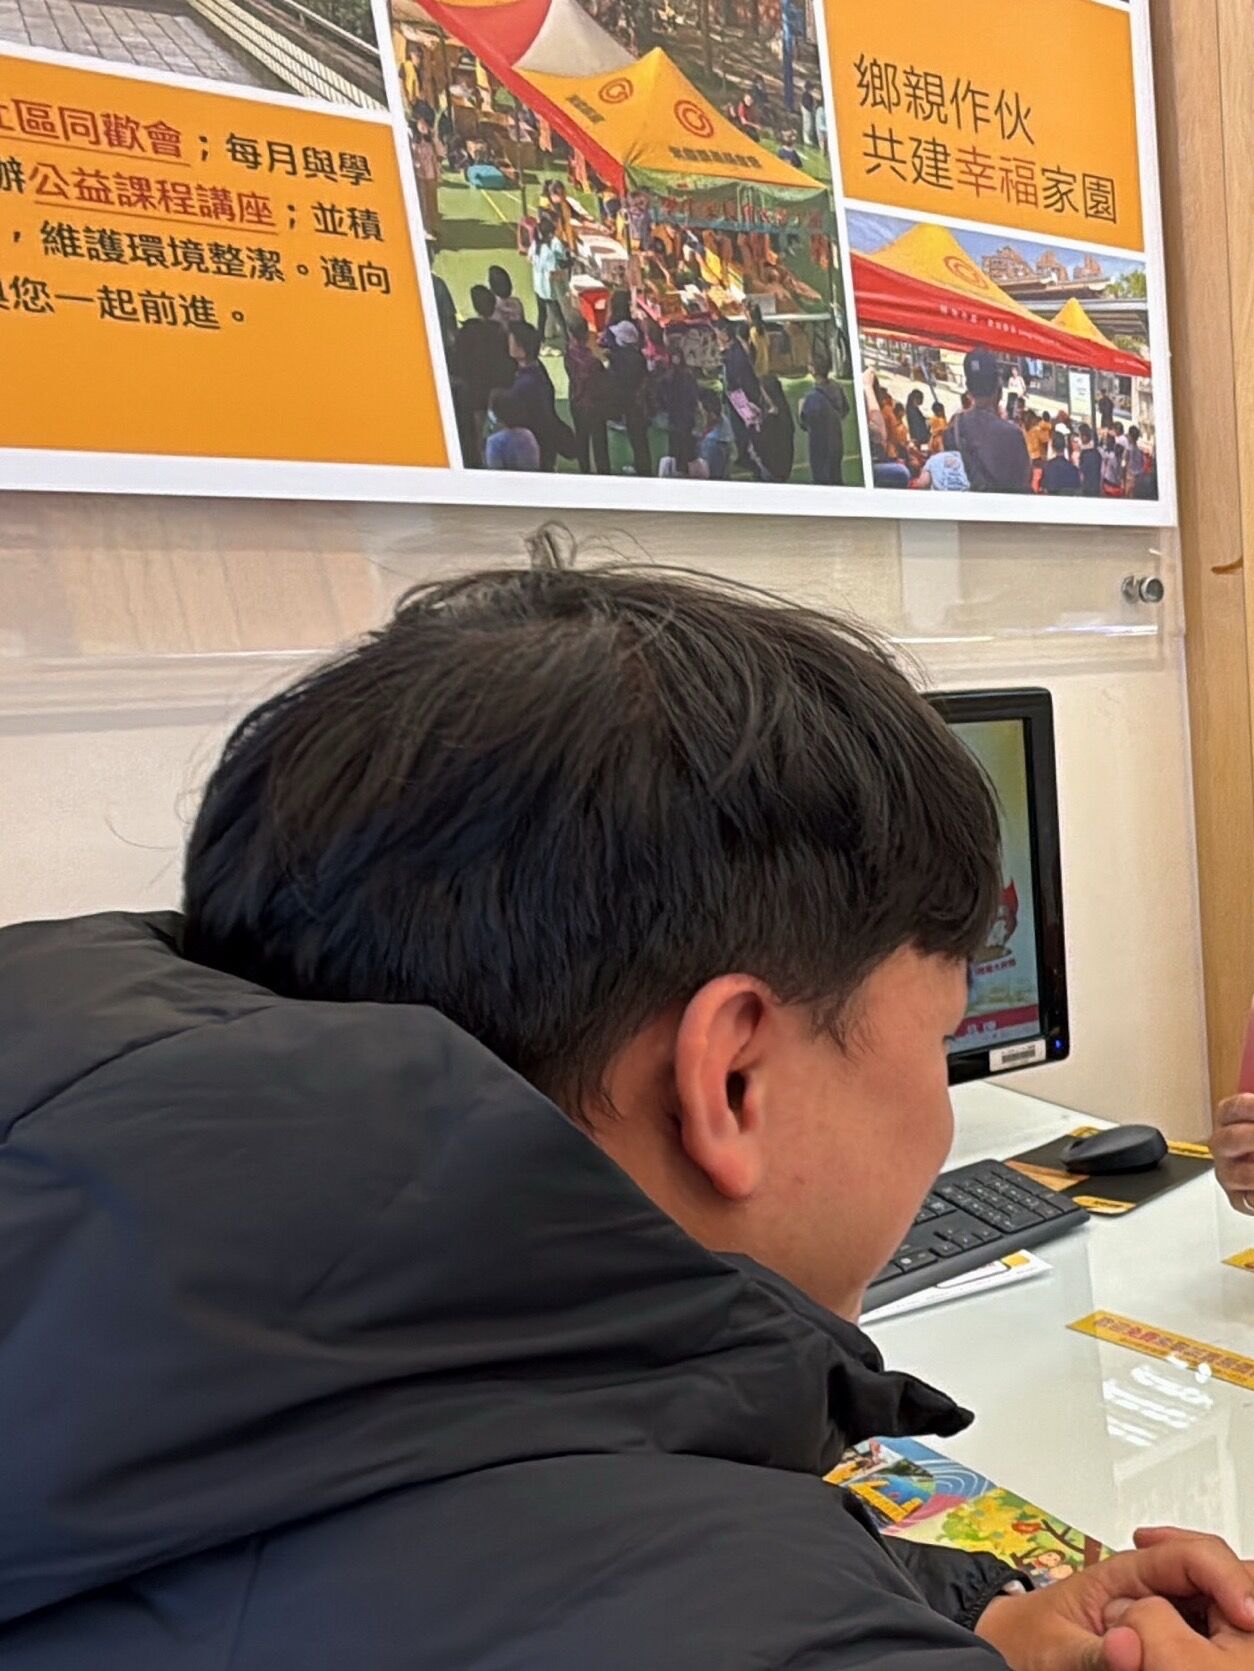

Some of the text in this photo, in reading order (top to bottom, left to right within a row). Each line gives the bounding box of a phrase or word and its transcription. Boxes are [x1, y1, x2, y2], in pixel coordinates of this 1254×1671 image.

[853, 54, 1035, 145] 鄉親作伙
[863, 123, 1117, 224] 共建幸福家園
[0, 275, 244, 330] 您一起前進。
